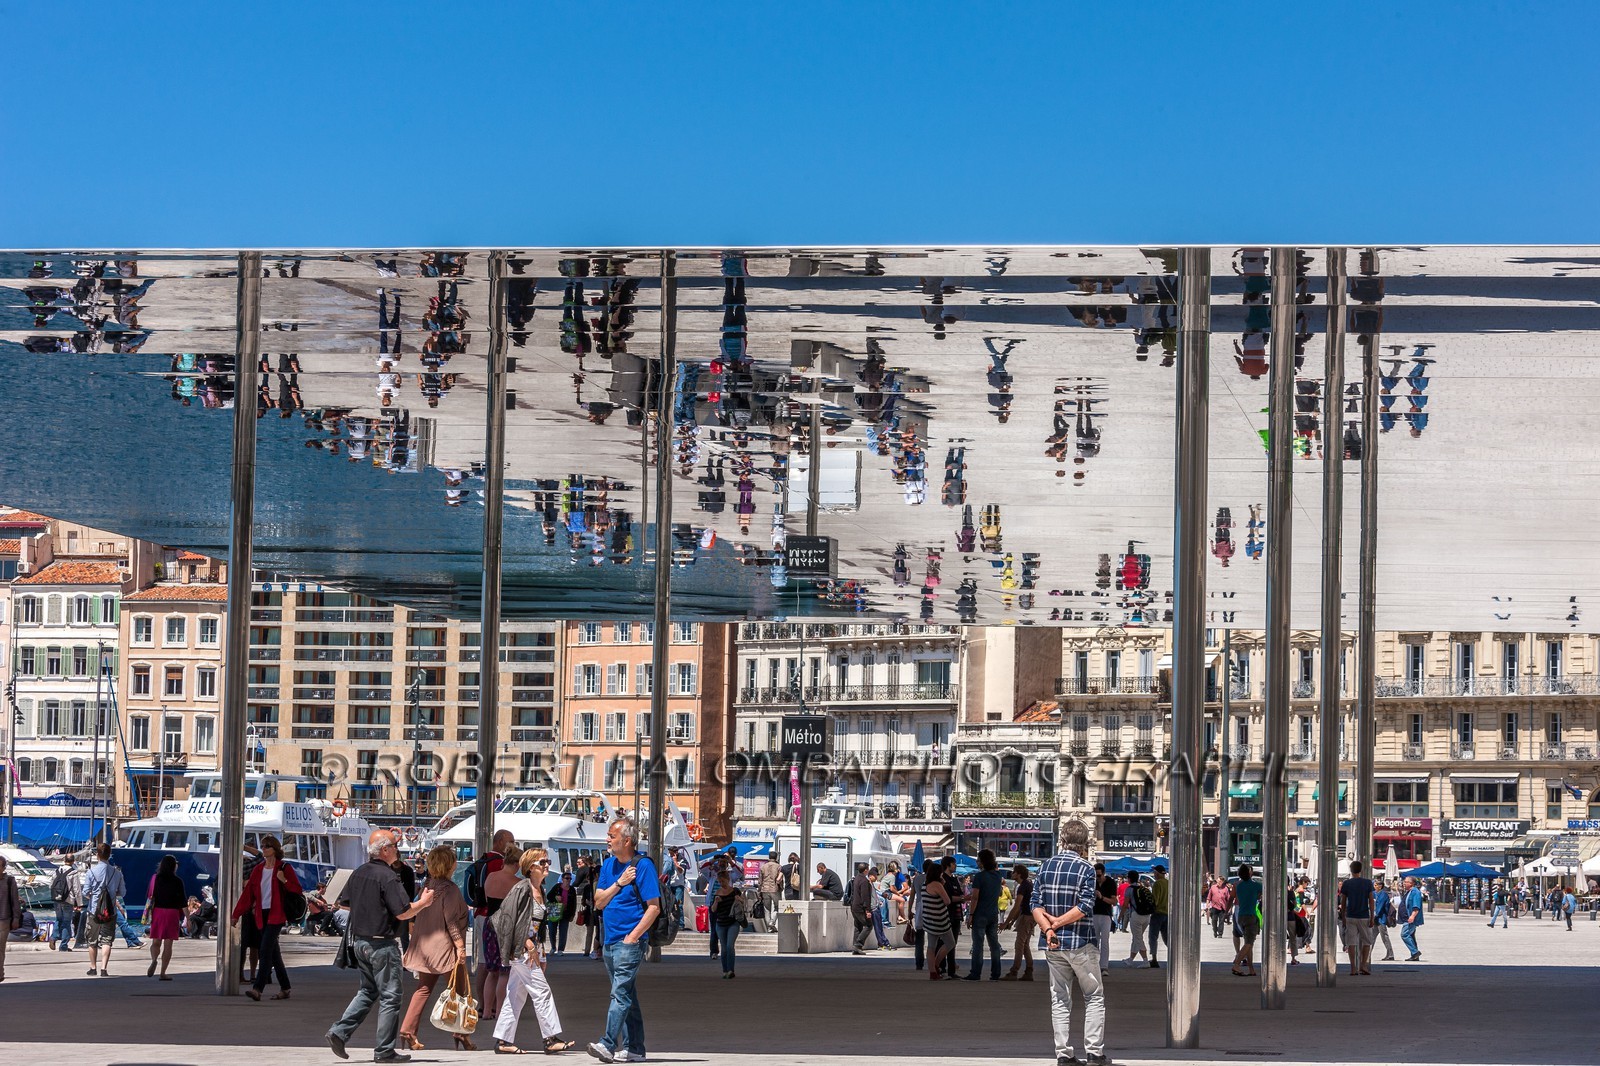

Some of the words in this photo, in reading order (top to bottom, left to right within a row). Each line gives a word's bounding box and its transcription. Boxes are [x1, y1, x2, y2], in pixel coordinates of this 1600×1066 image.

[785, 729, 822, 745] Métro
[188, 801, 222, 814] HELI
[285, 806, 312, 821] HELIOS
[974, 820, 996, 830] Petit
[1001, 819, 1041, 830] Pernod
[1374, 818, 1422, 829] Häagen-Dazs
[1449, 821, 1521, 831] RESTAURANT
[1567, 820, 1600, 829] BRASS
[1470, 830, 1489, 838] Table,
